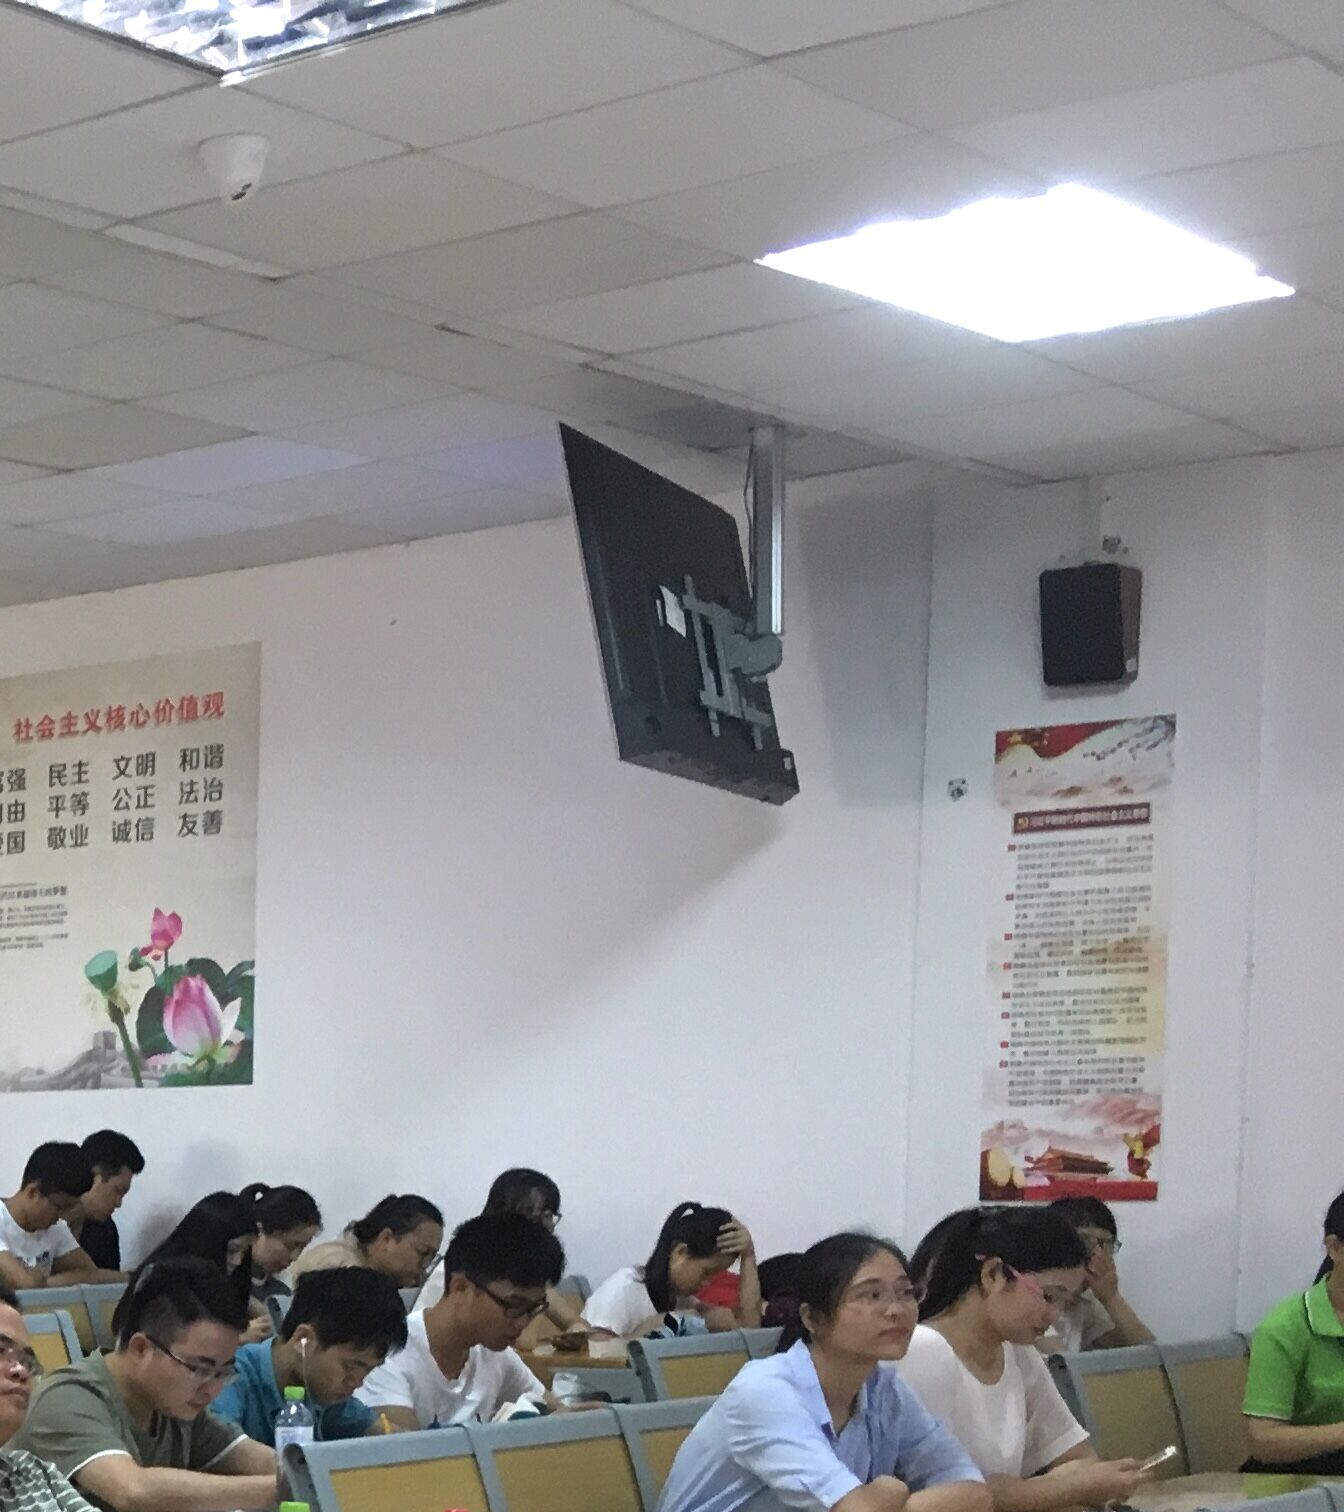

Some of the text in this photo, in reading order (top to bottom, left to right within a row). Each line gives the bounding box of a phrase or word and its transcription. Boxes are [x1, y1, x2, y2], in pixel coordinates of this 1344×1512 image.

[14, 691, 224, 743] 社会主义核心价值观
[48, 760, 90, 788] 民主
[112, 751, 157, 781] 文明
[178, 744, 224, 773] 和谐
[47, 791, 90, 819] 平等
[112, 783, 156, 812] 公正
[178, 777, 223, 805] 法治
[47, 823, 89, 850] 敬业
[112, 816, 155, 845] 诚信
[177, 809, 223, 838] 友善
